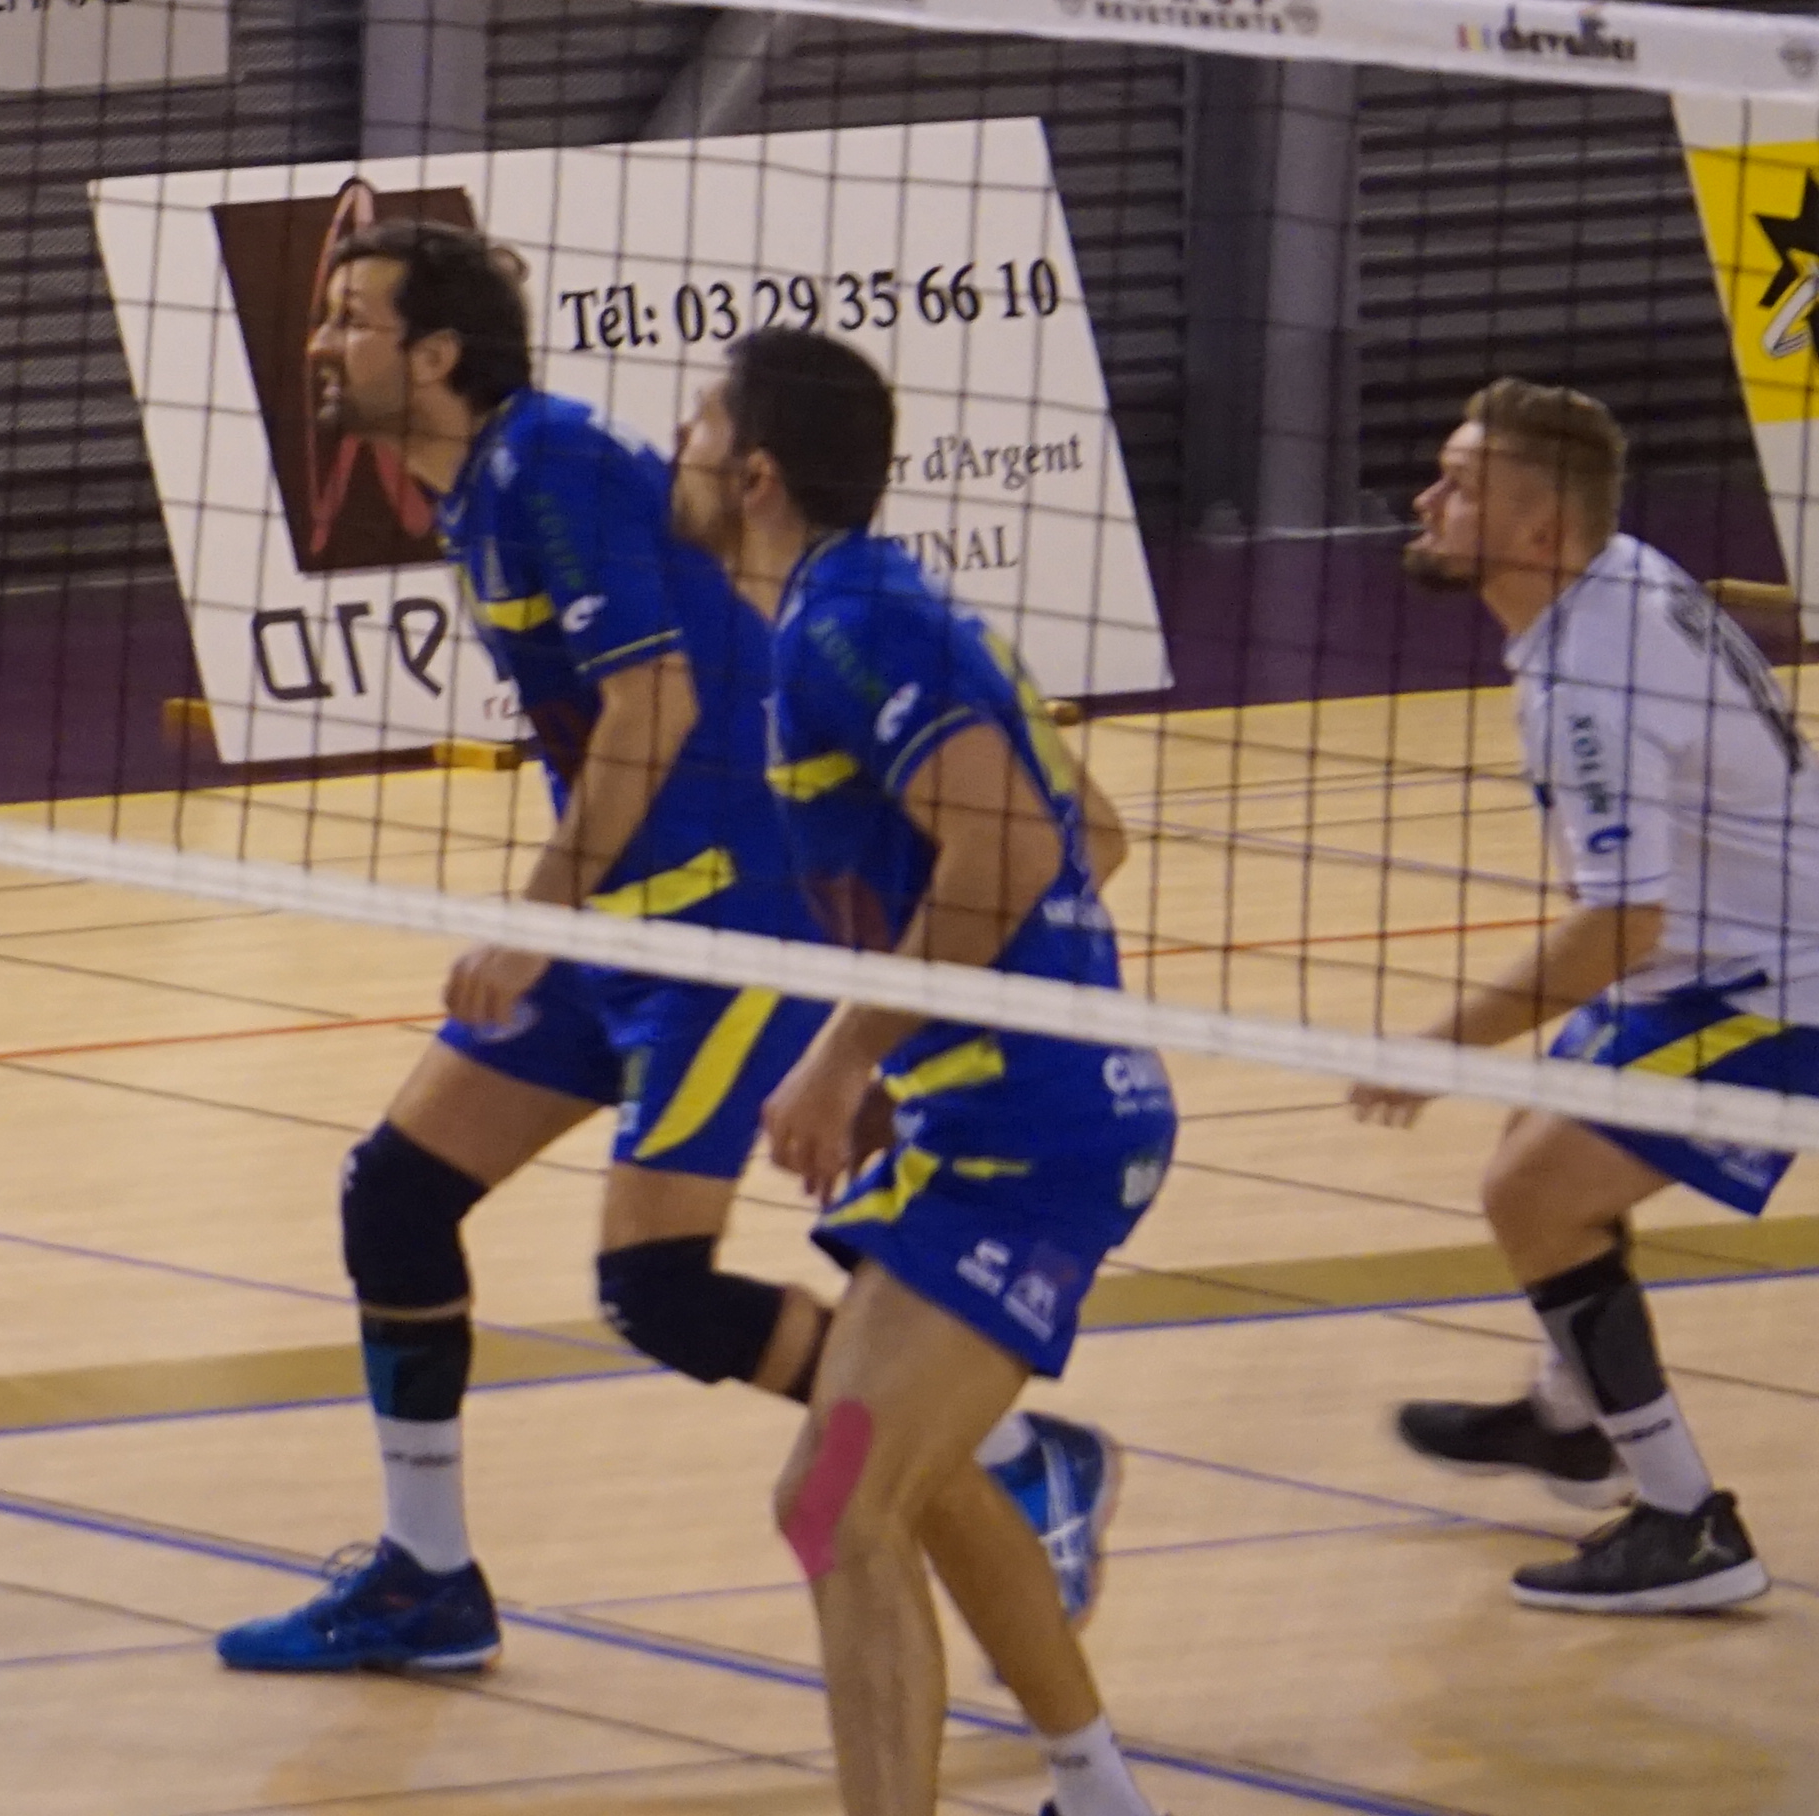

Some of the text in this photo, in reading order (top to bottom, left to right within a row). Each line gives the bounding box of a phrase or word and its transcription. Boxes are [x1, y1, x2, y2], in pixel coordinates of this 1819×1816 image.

[561, 258, 1059, 353] Tél: 03 29 35 66 10
[923, 432, 1083, 489] d'Argent
[893, 525, 1020, 573] INAL
